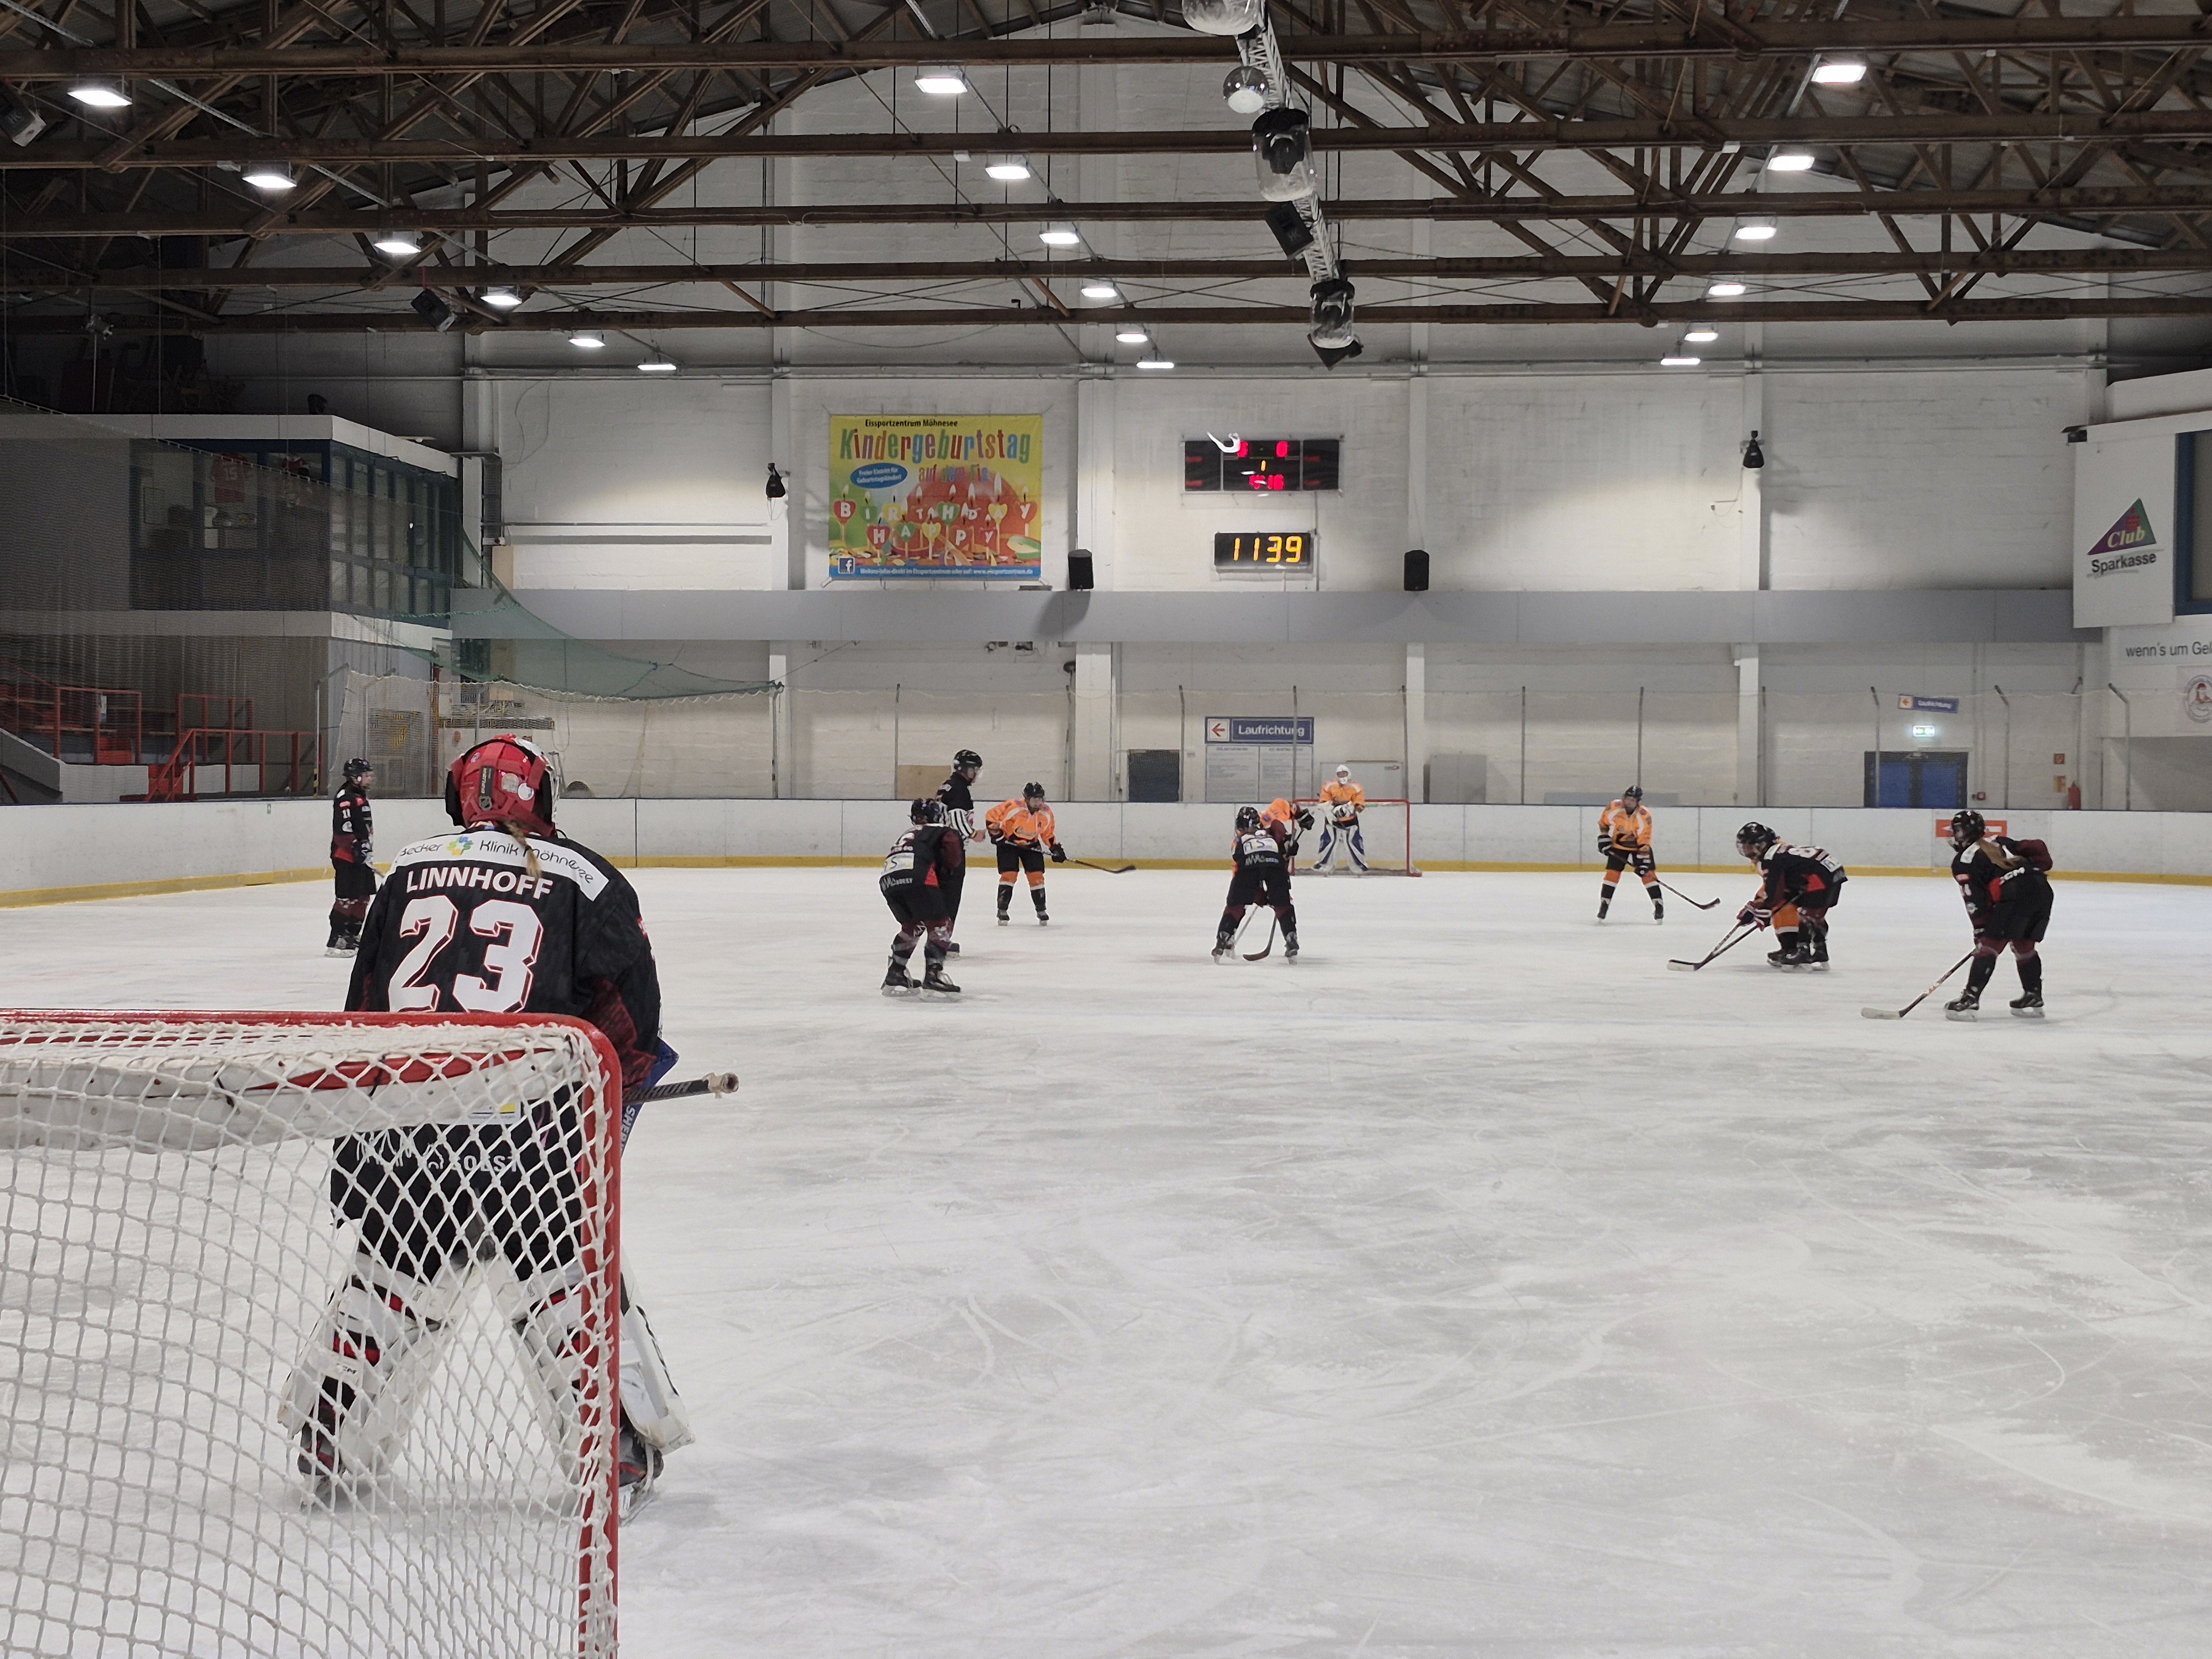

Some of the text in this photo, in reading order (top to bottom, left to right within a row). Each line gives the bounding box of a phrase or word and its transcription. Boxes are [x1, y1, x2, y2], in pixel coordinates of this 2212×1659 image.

[865, 419, 958, 428] Eissportzentrum Möhnesee
[839, 428, 1031, 464] Kindergeburtstag
[919, 463, 937, 483] auf
[941, 465, 965, 483] dem
[2107, 526, 2146, 549] Club
[2091, 553, 2157, 575] Sparkasse
[2126, 641, 2167, 657] wenn's
[2170, 645, 2188, 656] um
[1238, 725, 1305, 737] Laufrichtug
[479, 839, 519, 856] Klinik
[405, 866, 554, 899] LINNHOFF
[388, 895, 544, 1013] 23
